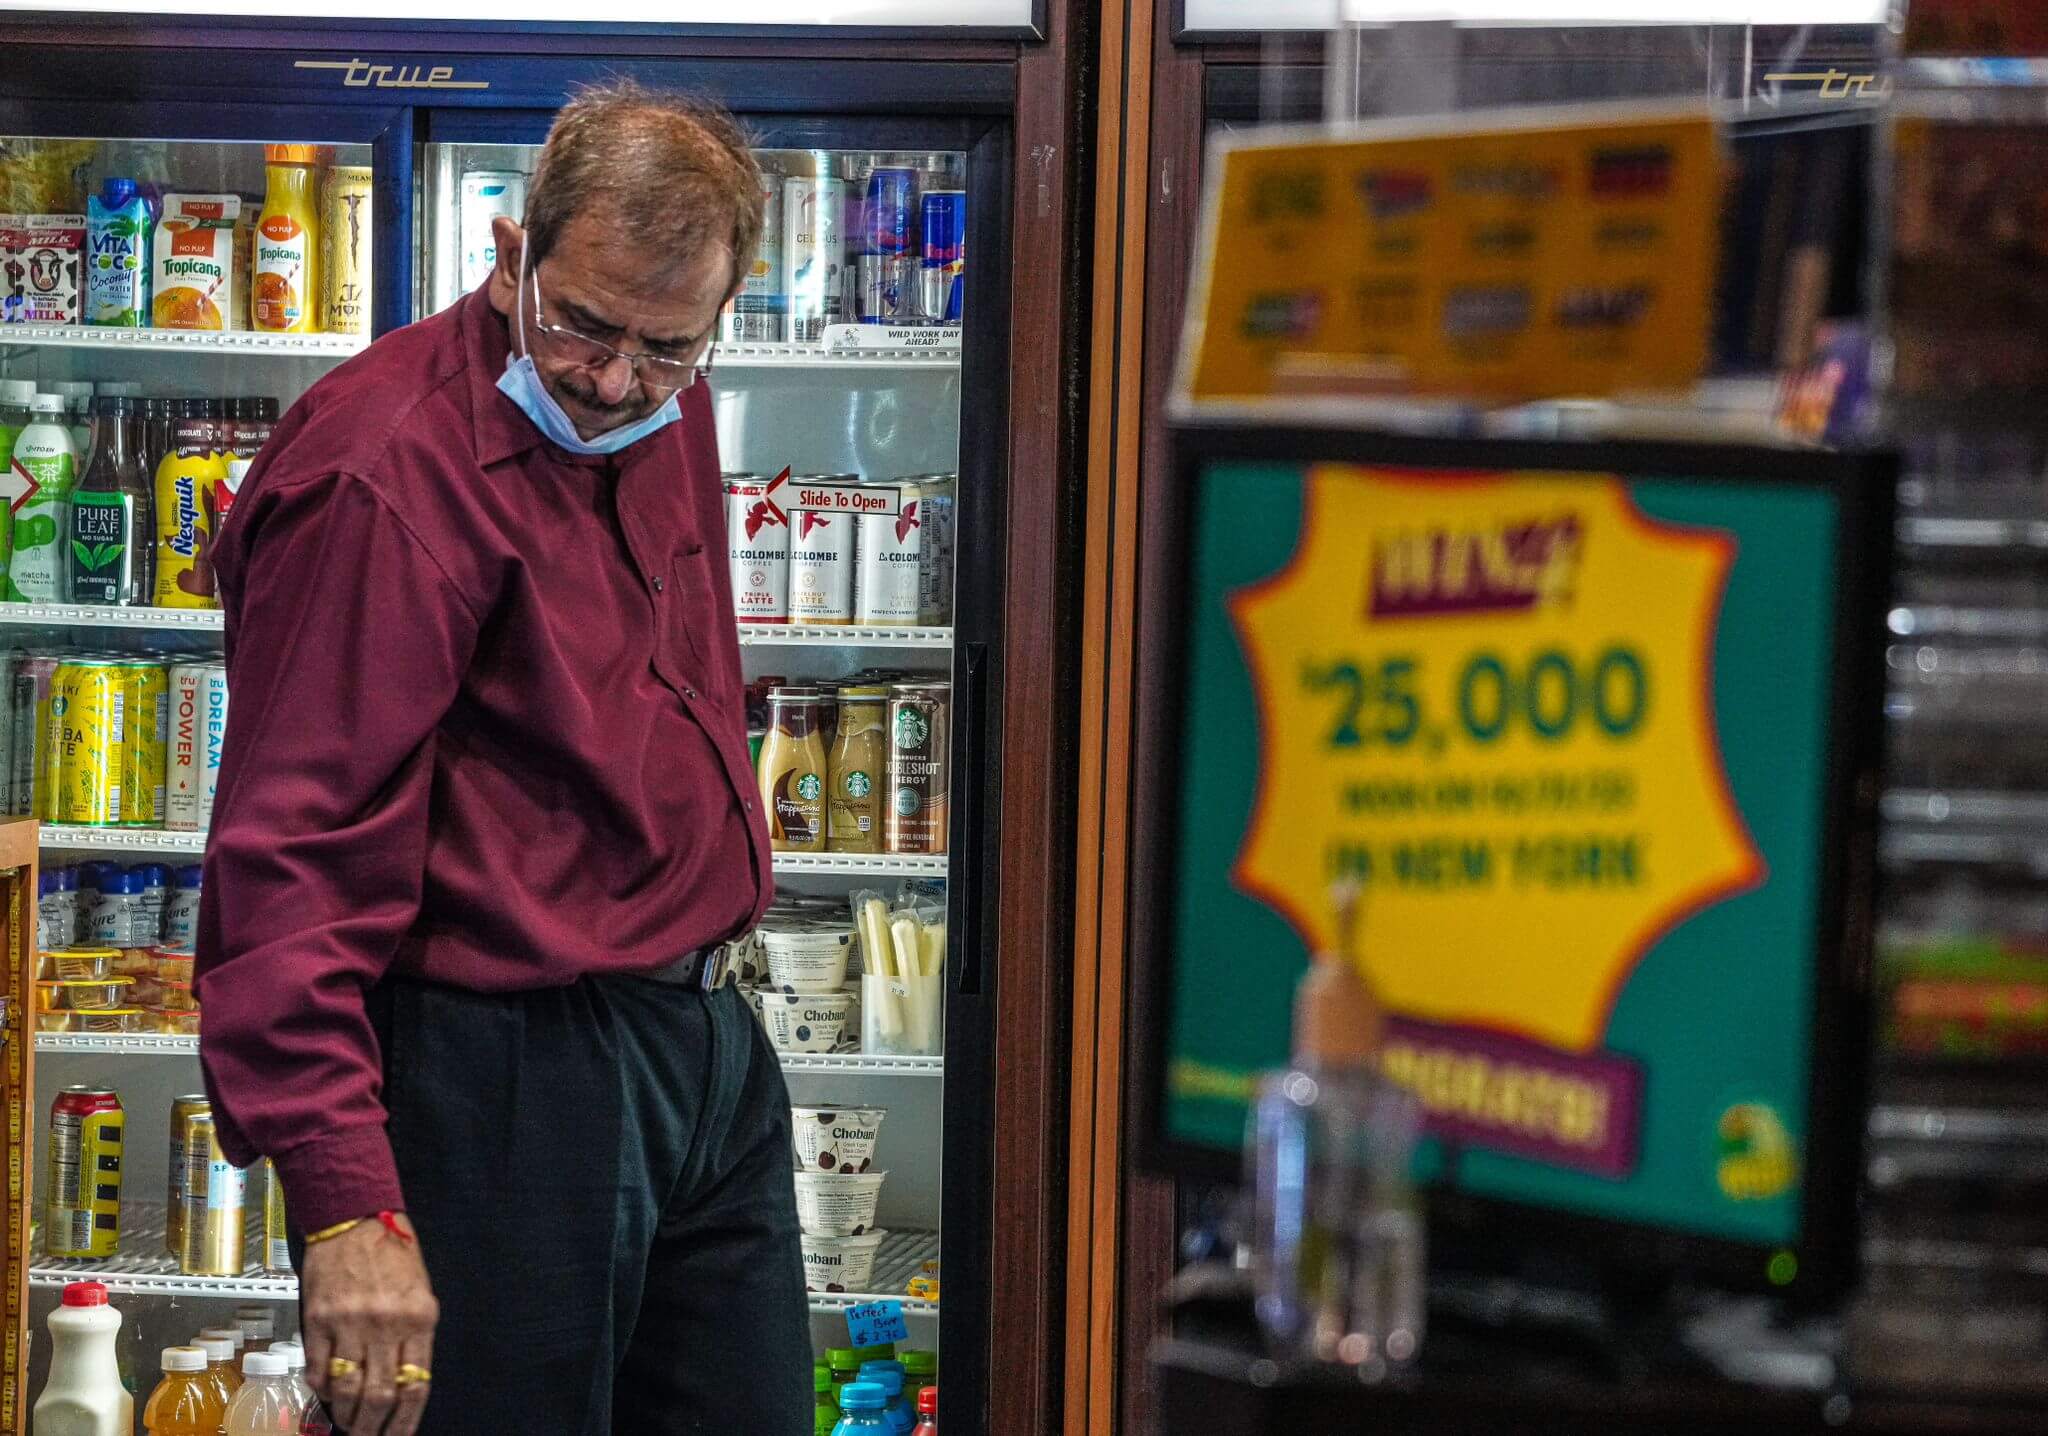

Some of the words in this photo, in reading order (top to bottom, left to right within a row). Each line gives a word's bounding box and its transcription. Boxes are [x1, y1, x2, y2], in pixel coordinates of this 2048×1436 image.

[294, 58, 489, 88] true
[92, 232, 132, 254] VITA
[797, 233, 837, 244] CELUS
[259, 247, 301, 261] Tropicana
[89, 253, 138, 271] COCO
[162, 258, 221, 277] Tropicana
[90, 268, 131, 291] Coconut
[24, 309, 66, 320] MILK
[888, 330, 911, 338] WILD
[943, 330, 960, 338] DAY
[904, 338, 940, 346] AHEAD?
[799, 490, 831, 506] Slide
[834, 492, 848, 507] To
[852, 493, 886, 512] Open
[78, 507, 120, 521] PURE
[173, 477, 200, 556] Nesquik
[78, 520, 119, 534] LEAF
[740, 550, 785, 560] COLOMBE
[180, 676, 195, 686] tru
[177, 689, 195, 767] POWER
[207, 692, 223, 768] DREAM
[832, 1127, 876, 1140] Chobani
